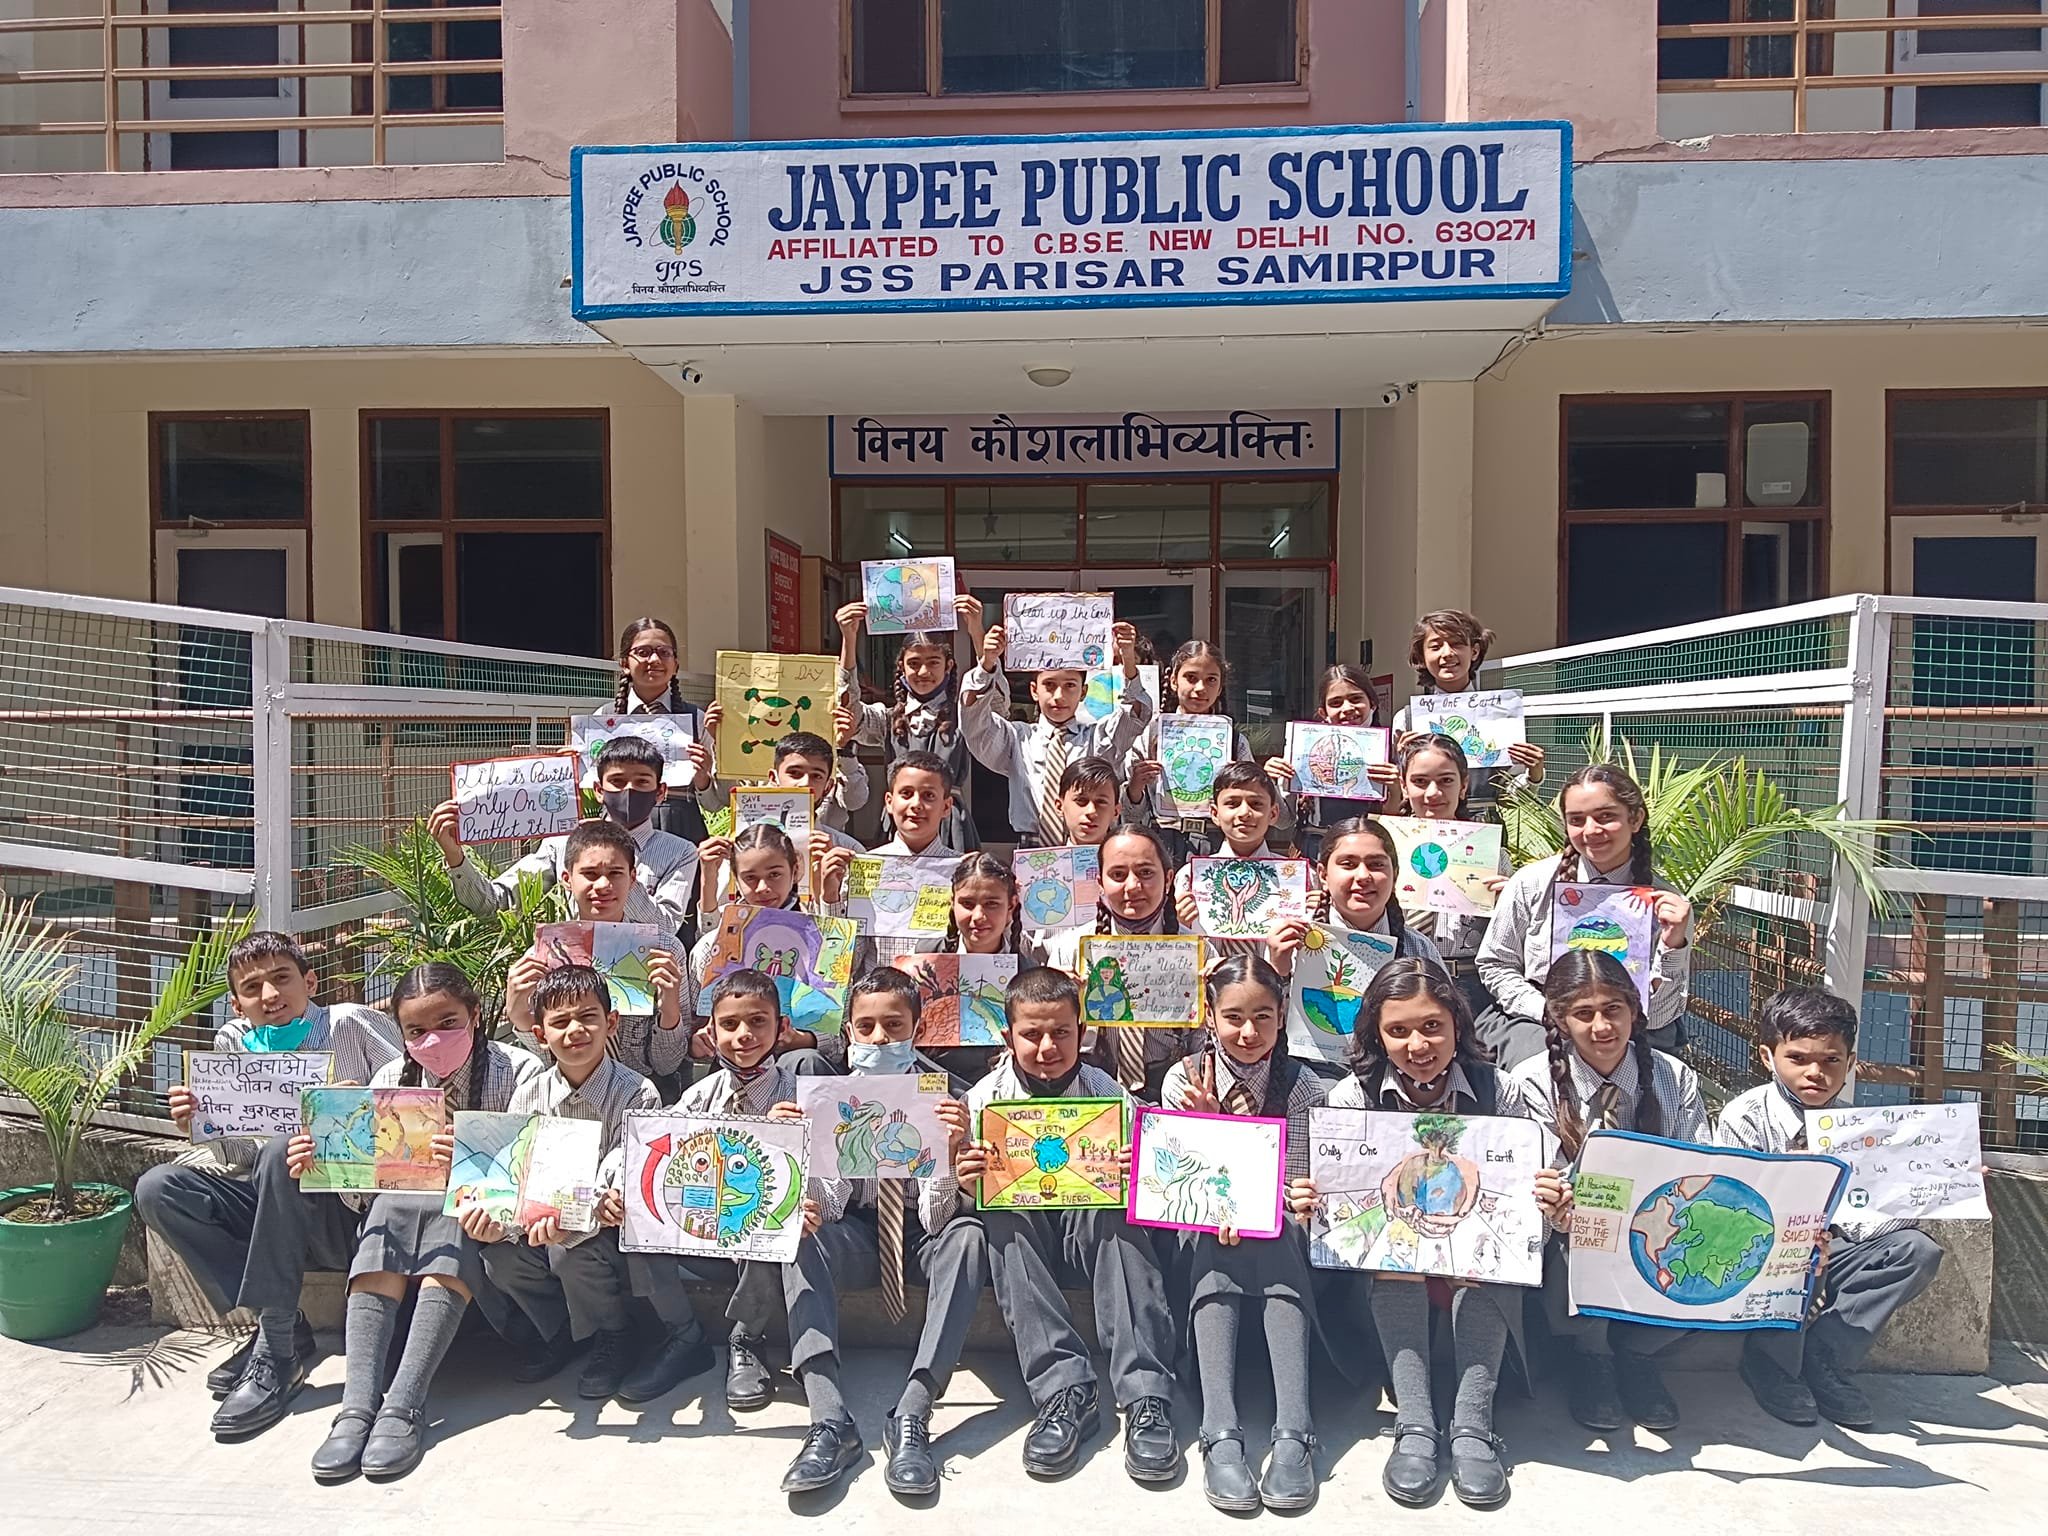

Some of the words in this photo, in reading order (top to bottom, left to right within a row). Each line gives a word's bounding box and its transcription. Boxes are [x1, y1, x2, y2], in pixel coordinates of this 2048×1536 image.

[768, 161, 1001, 232] JAYPEE
[1021, 153, 1241, 227] PUBLIC
[1268, 144, 1530, 221] SCHOOL
[622, 186, 644, 248] JAYPEE
[639, 163, 705, 190] PUBLIC
[705, 179, 732, 247] SCHOOL
[767, 236, 939, 261] AFFILIATED
[968, 235, 1004, 256] TO
[1034, 231, 1129, 255] C.B.S.E.
[1149, 229, 1212, 251] NEW
[1237, 226, 1329, 249] DELHI
[1358, 223, 1414, 246] NO.
[1435, 219, 1537, 243] 630271
[800, 264, 914, 295] JSS
[941, 258, 1185, 292] PARISAR
[1217, 249, 1496, 286] SAMIRPUR
[852, 417, 949, 463] विनय
[1048, 609, 1068, 630] up
[457, 761, 503, 800] Life
[192, 1053, 243, 1077] धरती
[1006, 1109, 1043, 1121] WORLD
[1318, 1143, 1342, 1161] Only
[1359, 1143, 1378, 1157] One
[1486, 1149, 1515, 1164] Earth
[1593, 1216, 1608, 1227] WE
[1787, 1214, 1812, 1227] HOW
[1574, 1235, 1607, 1248] PLANET
[1593, 1226, 1610, 1239] THE
[1780, 1229, 1810, 1243] SAVED
